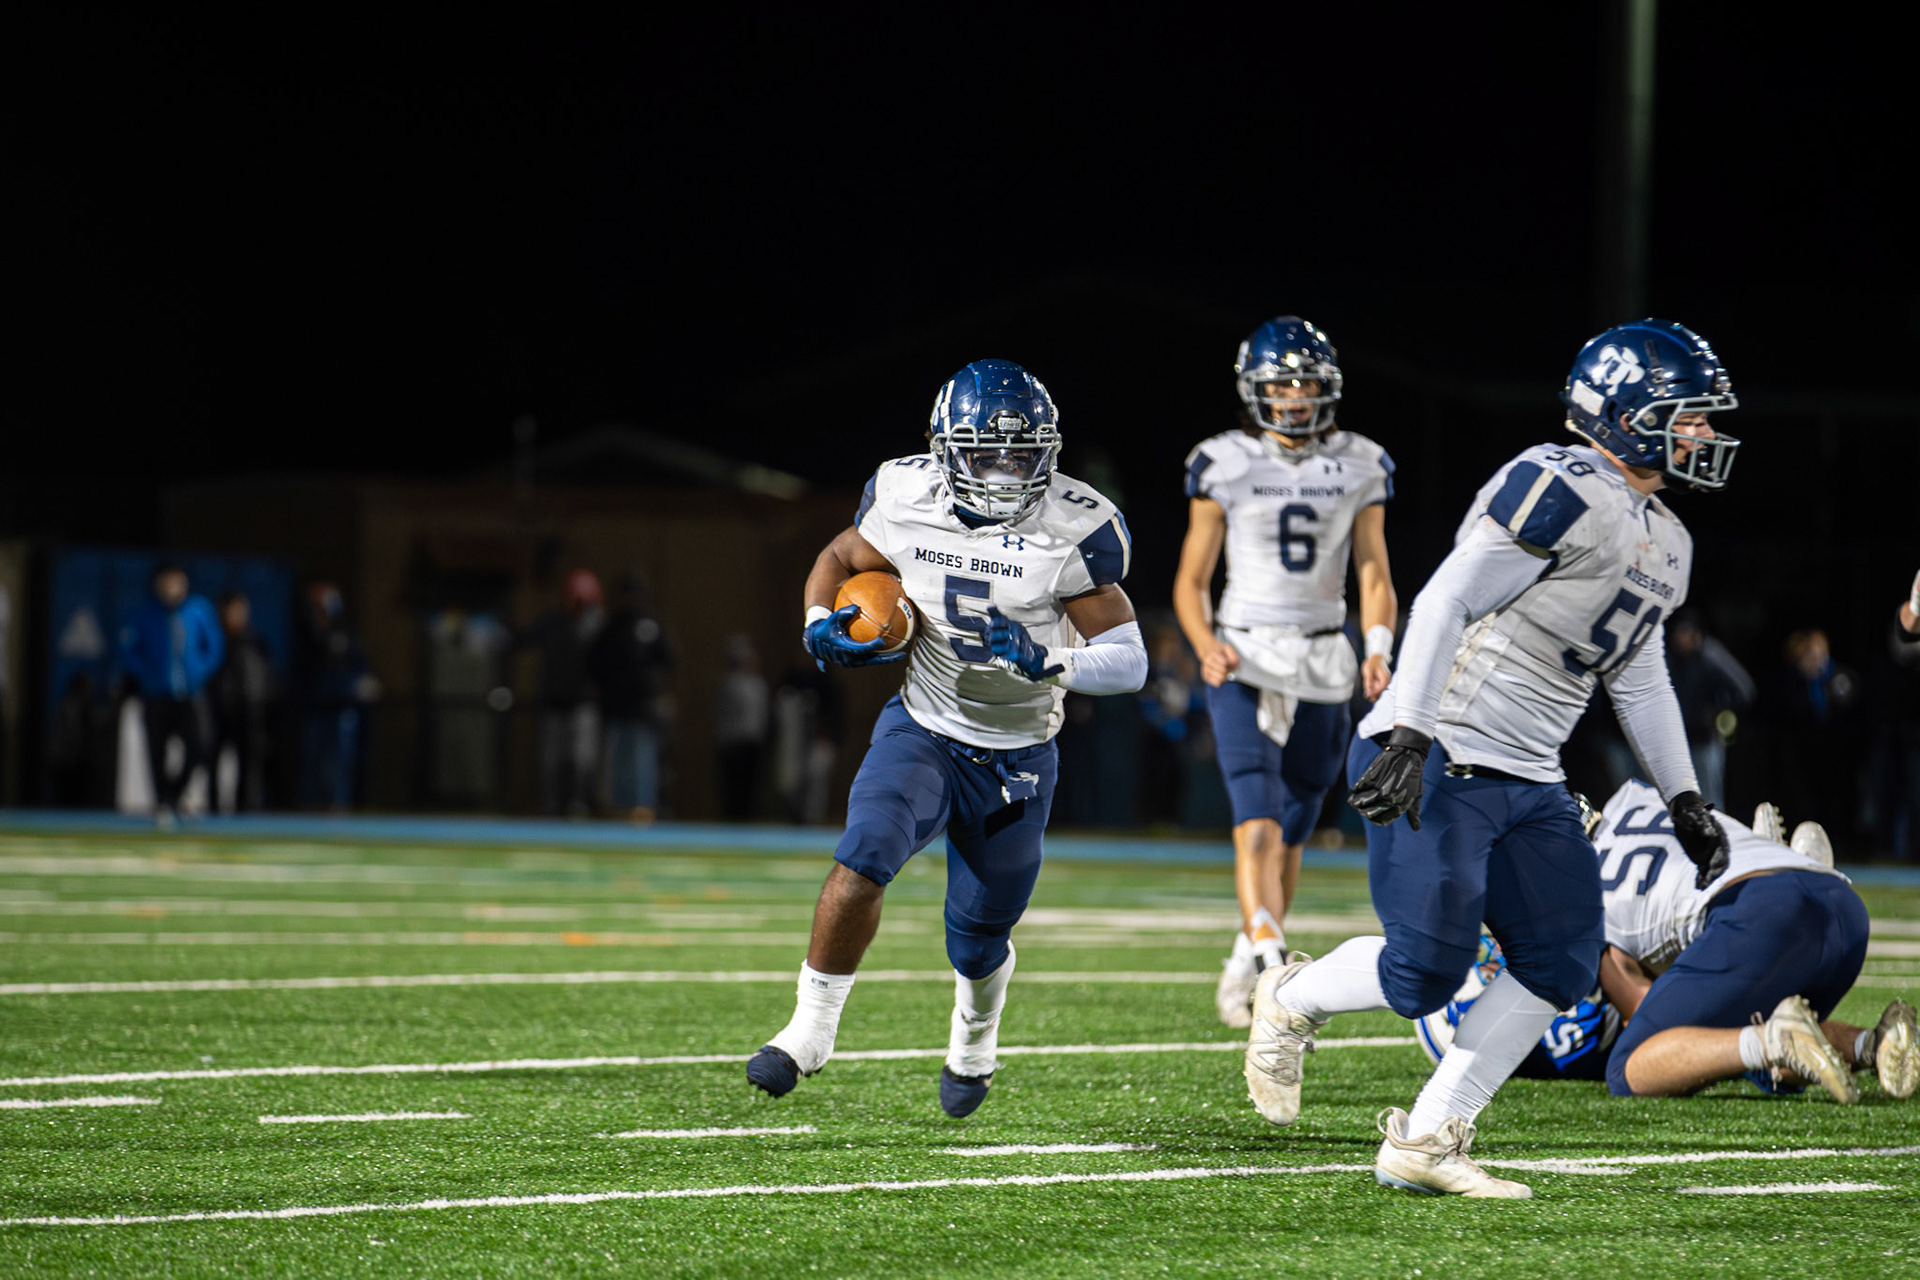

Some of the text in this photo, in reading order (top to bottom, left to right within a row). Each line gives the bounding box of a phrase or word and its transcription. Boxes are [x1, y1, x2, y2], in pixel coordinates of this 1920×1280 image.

[895, 457, 931, 469] 5
[1545, 450, 1597, 477] 58
[1062, 489, 1099, 510] 5
[1252, 483, 1346, 497] MOSES BROWN
[1279, 503, 1319, 573] 6
[915, 547, 1024, 579] MOSES BROWN
[944, 573, 999, 664] 5
